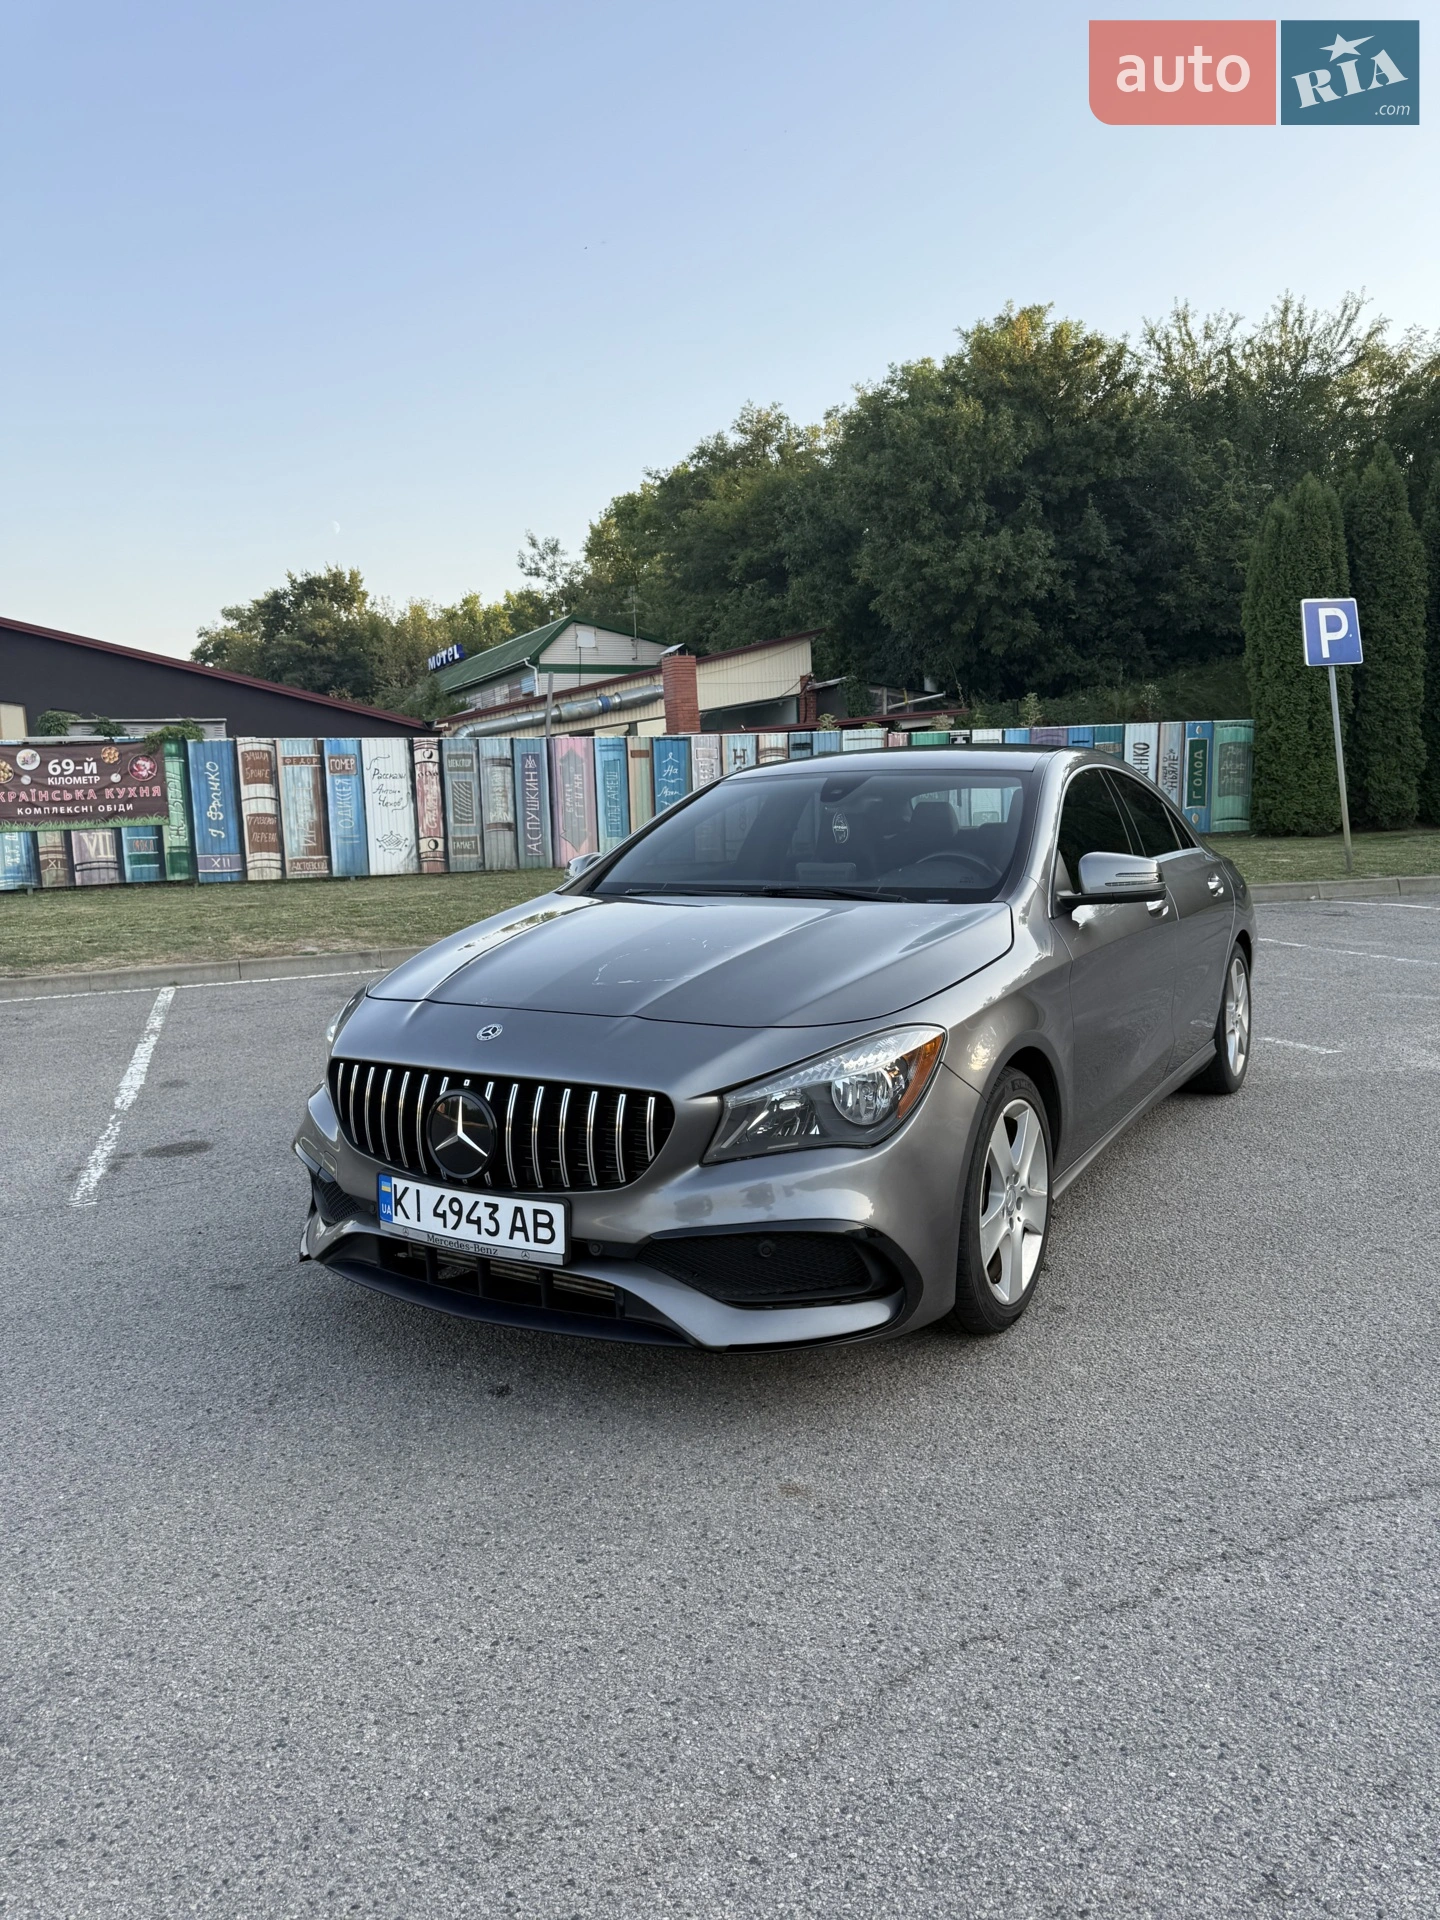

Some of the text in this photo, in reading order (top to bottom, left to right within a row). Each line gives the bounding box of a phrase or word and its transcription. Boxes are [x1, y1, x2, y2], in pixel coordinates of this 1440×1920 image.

[1318, 607, 1349, 659] P
[284, 757, 318, 765] ФЕДОР
[329, 757, 355, 771] ГОМЕР
[1133, 742, 1150, 778] ЕНКО
[47, 775, 100, 786] КІЛОМЕТР
[1192, 749, 1204, 799] ГОЛОД
[105, 786, 162, 799] КУХНЯ
[335, 778, 355, 829] ОДИССЕЯ
[606, 770, 622, 833] ГИЛЬГАМЕШ
[17, 803, 134, 815] КОМПЛЕКСНІ ОБІДИ
[80, 832, 116, 859] VII
[211, 858, 231, 869] XII
[382, 1203, 392, 1215] UA
[393, 1183, 556, 1245] KI 4943 AB
[426, 1233, 498, 1255] Mercedes-Benz
